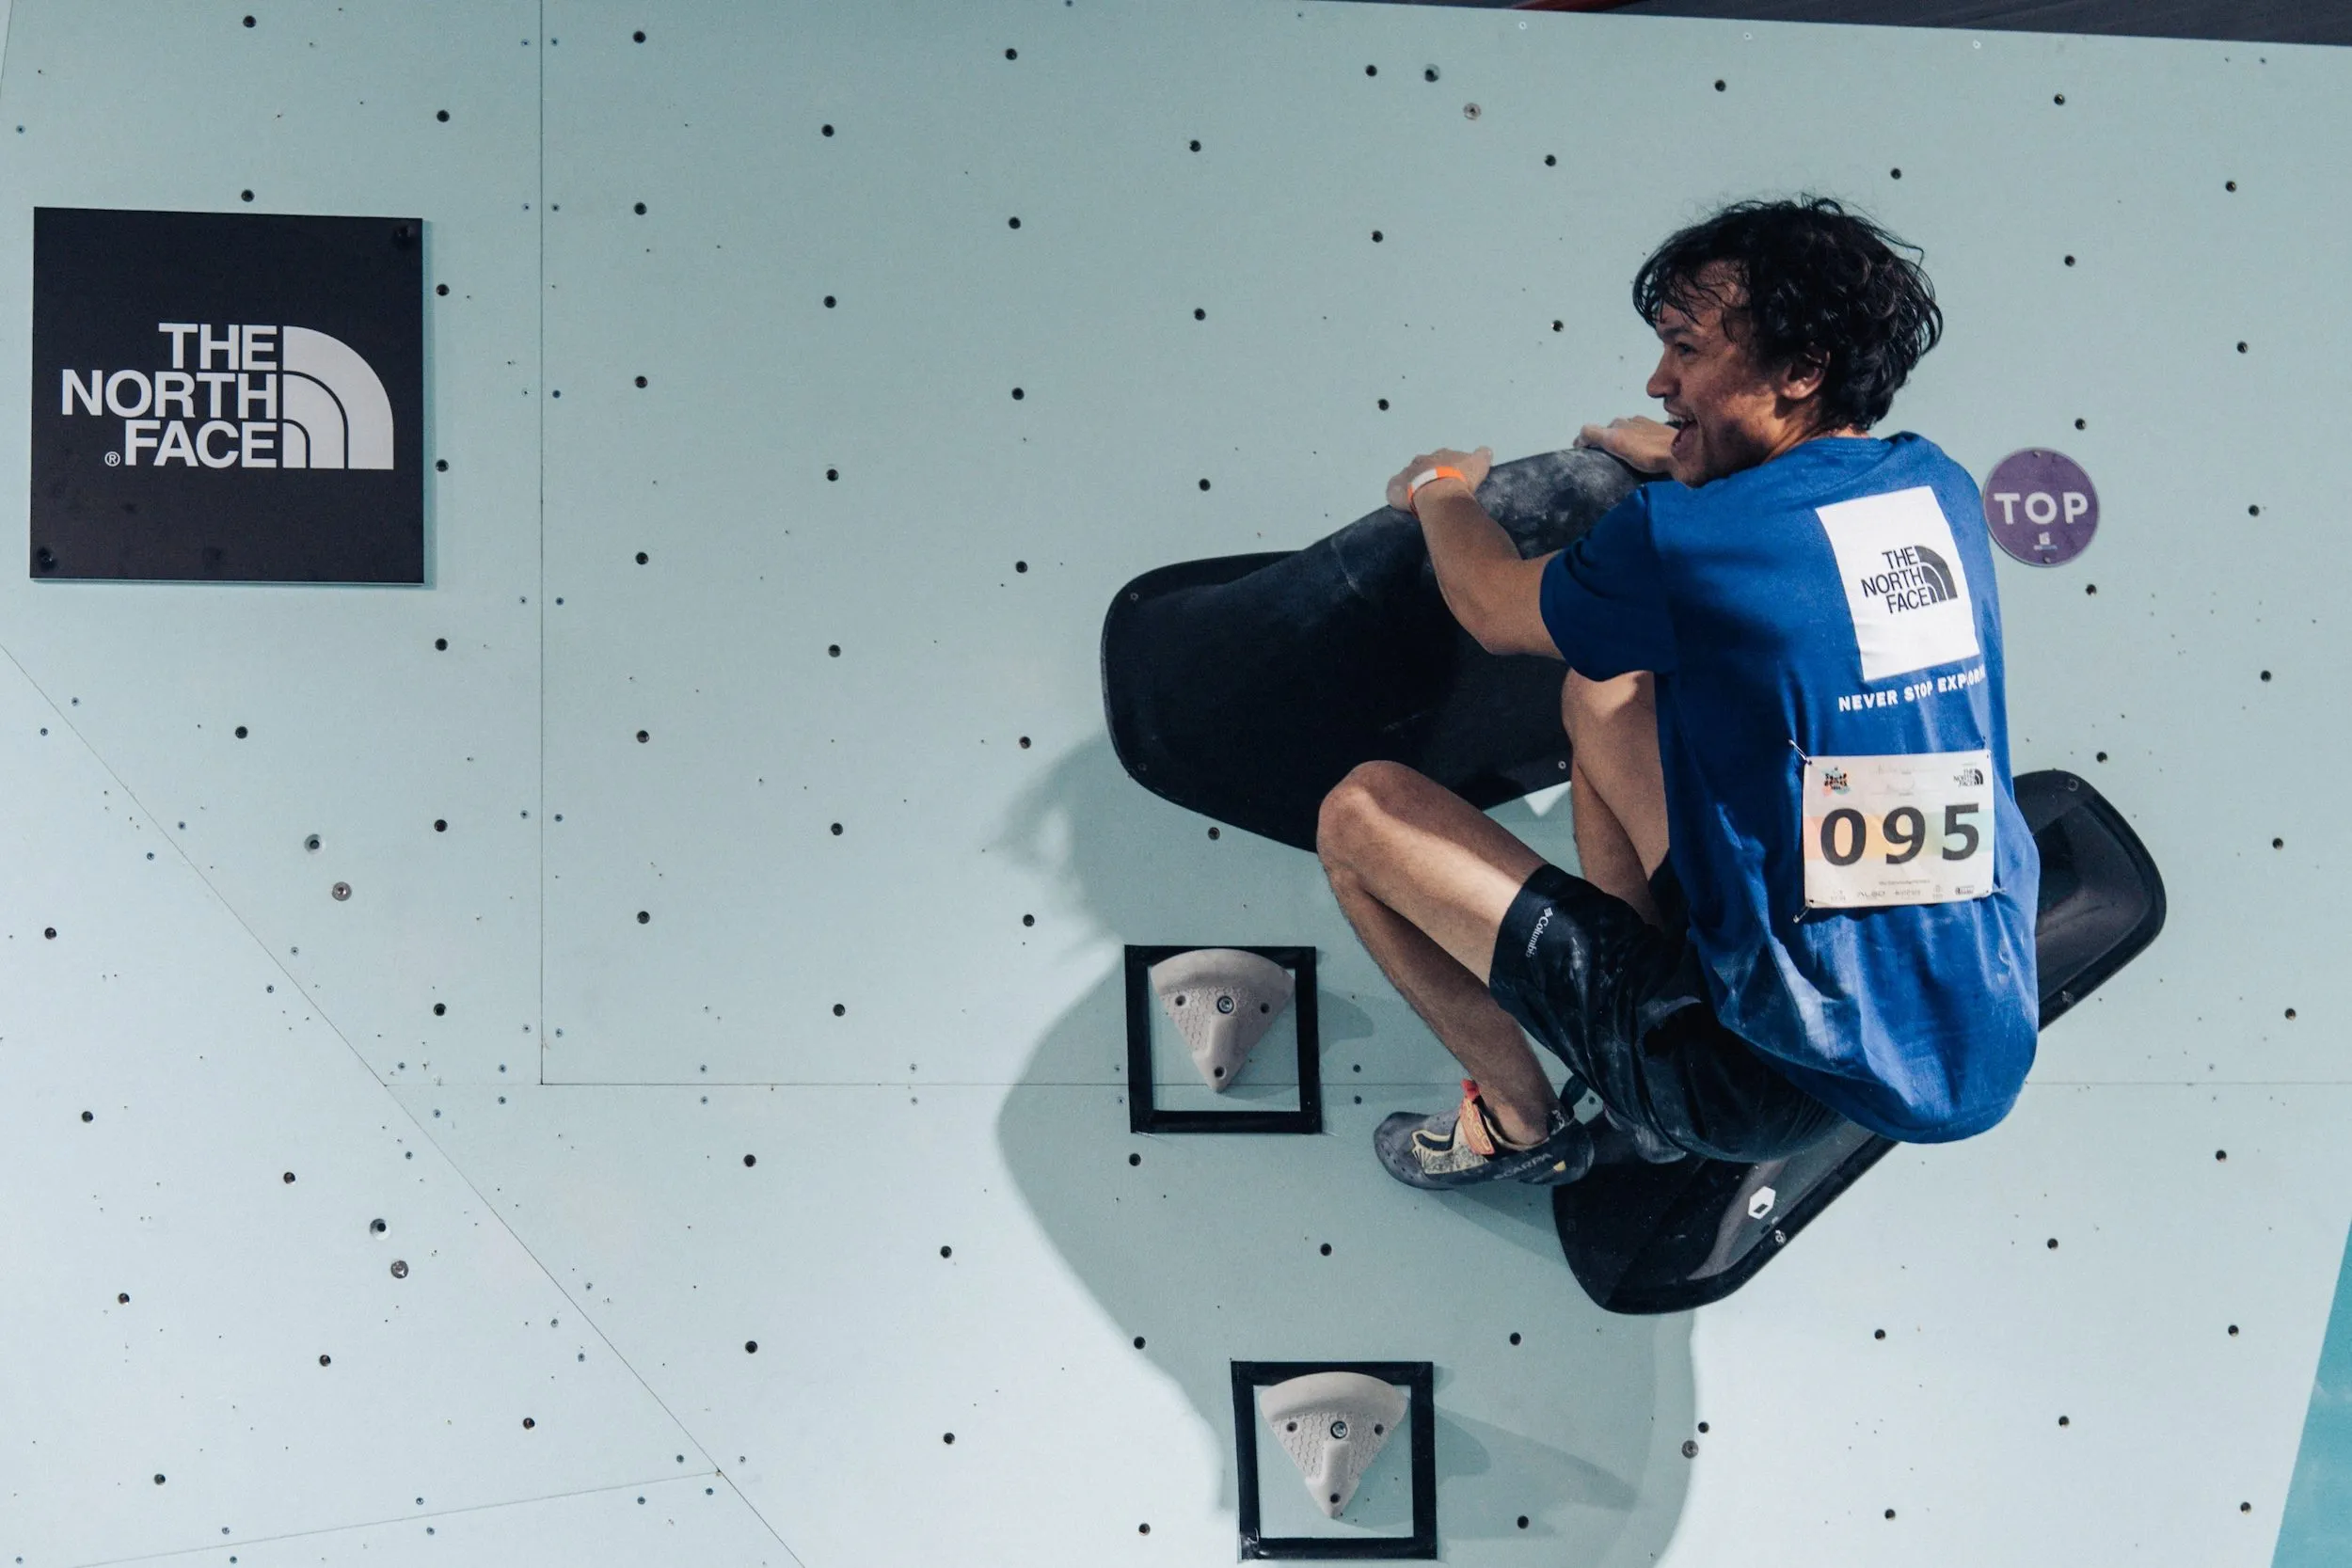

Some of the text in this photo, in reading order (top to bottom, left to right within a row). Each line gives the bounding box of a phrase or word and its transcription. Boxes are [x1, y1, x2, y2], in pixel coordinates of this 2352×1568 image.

[158, 323, 278, 371] THE
[62, 369, 278, 420] NORTH
[124, 420, 278, 469] FACE
[1993, 491, 2089, 525] TOP
[1882, 546, 1919, 570] THE
[1860, 565, 1925, 598] NORTH
[1885, 586, 1931, 615] FACE
[1837, 689, 1899, 712] NEVER
[1903, 680, 1934, 703] STOP
[1820, 802, 1980, 866] 095
